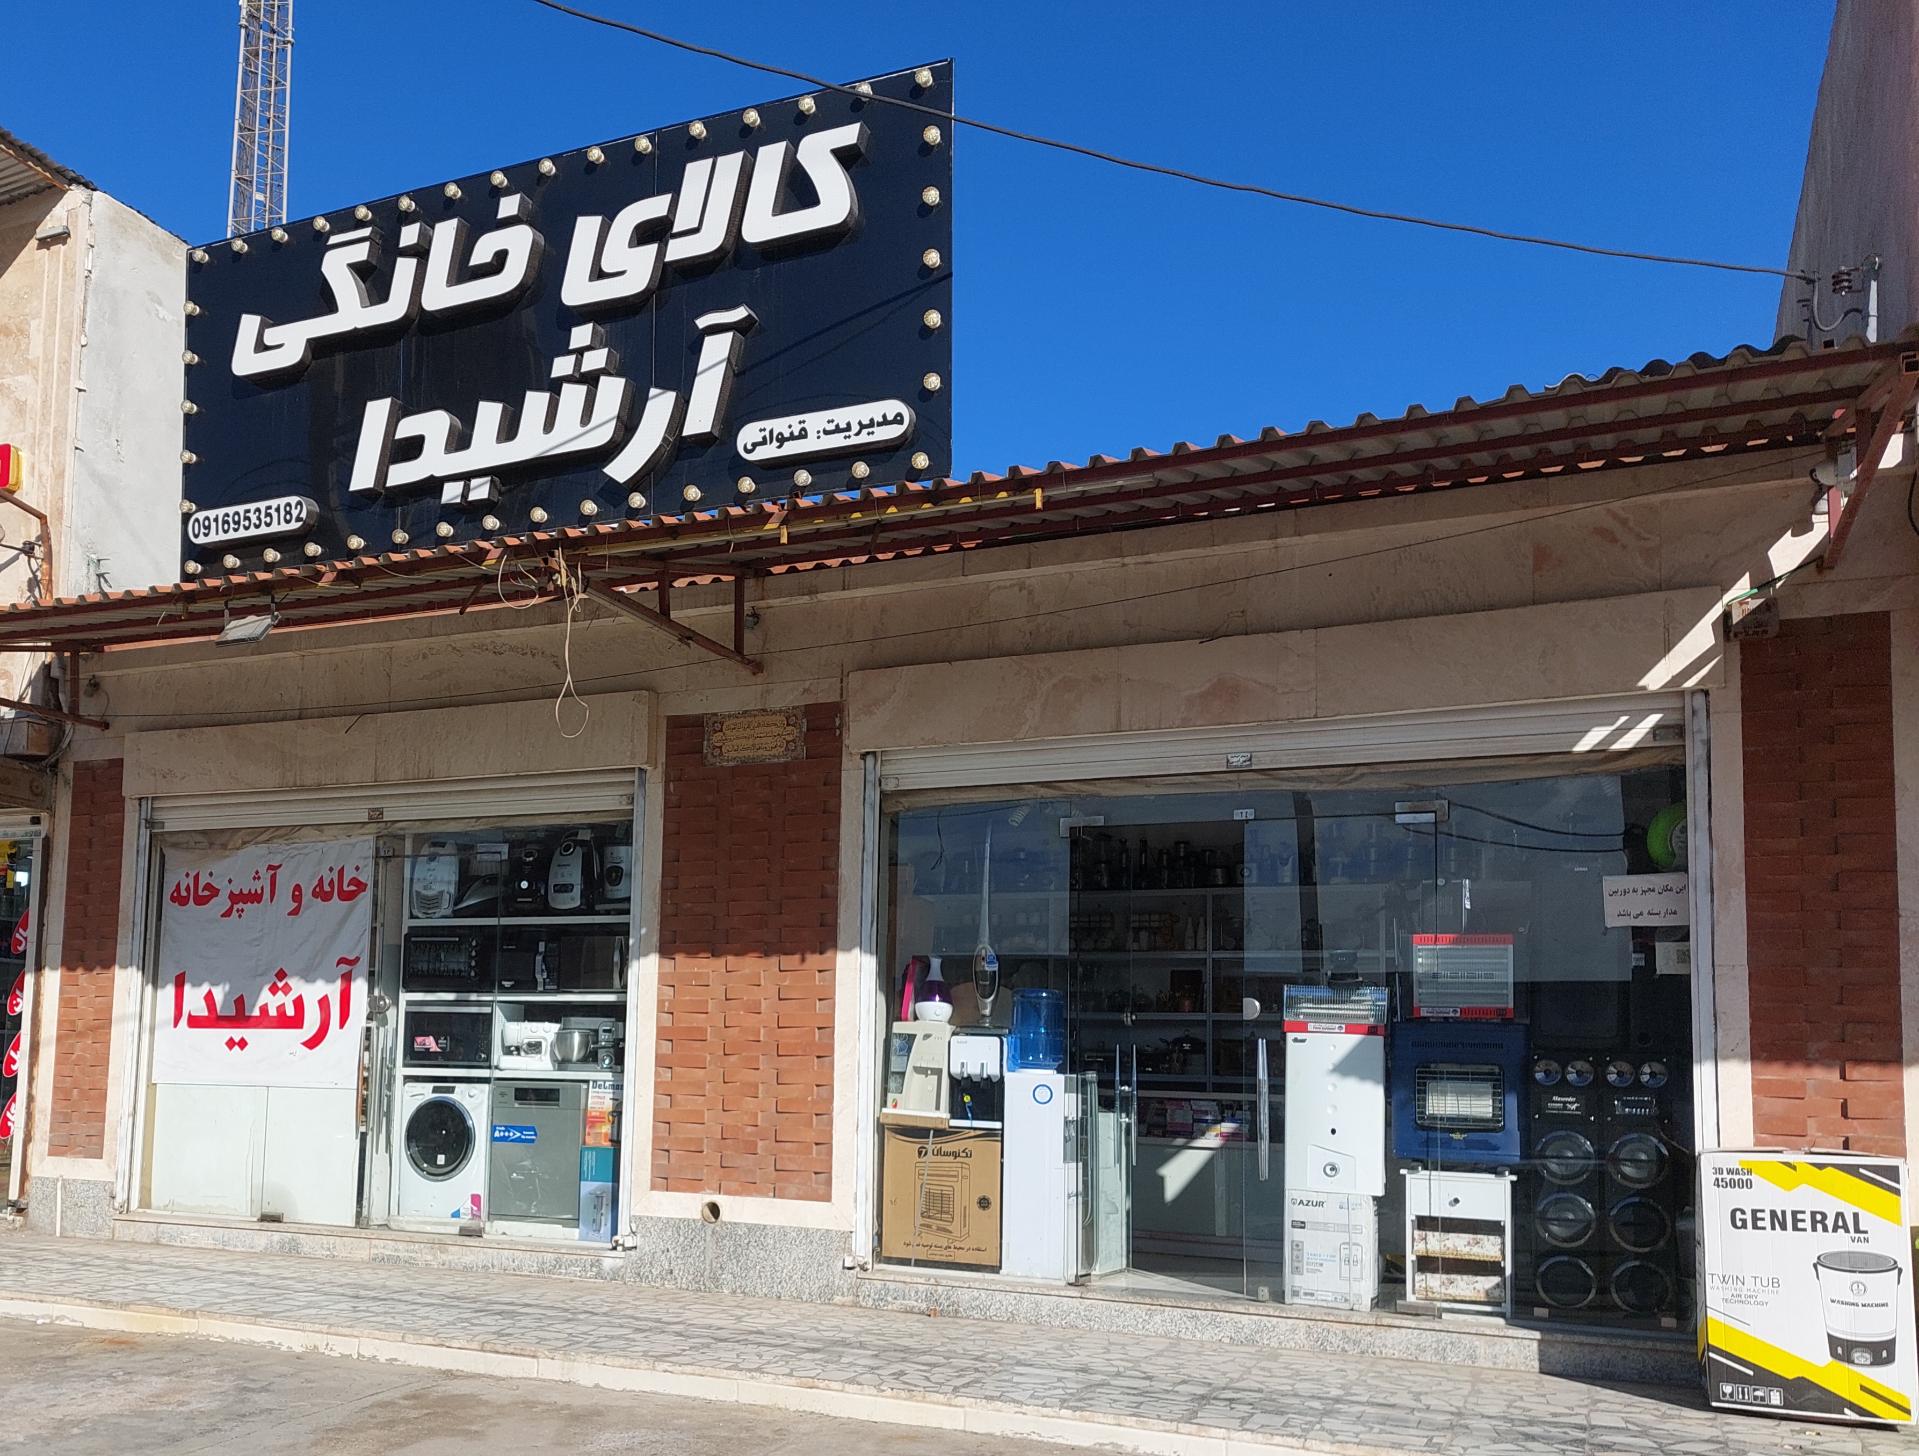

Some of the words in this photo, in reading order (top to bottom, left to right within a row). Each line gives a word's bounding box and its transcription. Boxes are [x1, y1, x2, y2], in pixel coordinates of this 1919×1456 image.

[561, 122, 869, 308] کالای
[231, 193, 534, 377] خانگی
[348, 303, 755, 503] آرشیدا
[743, 418, 809, 454] قنواتی
[191, 499, 304, 540] 09169535182
[311, 864, 369, 903] خانه
[1657, 884, 1674, 894] مکان
[1675, 884, 1687, 894] این
[169, 863, 284, 919] آشپزخانه
[1608, 887, 1630, 897] دوربین
[1640, 886, 1656, 896] مجهز
[287, 882, 304, 918] و
[1616, 909, 1632, 918] باشد
[1632, 910, 1644, 919] می
[1646, 909, 1661, 917] بسته
[1662, 908, 1678, 918] مدار
[172, 955, 362, 1052] آرشیدا
[1712, 1167, 1724, 1176] 3D
[1725, 1167, 1753, 1177] WASH
[1713, 1177, 1753, 1190] 45000
[1297, 1199, 1325, 1208] AZUR
[1730, 1207, 1869, 1235] GENERAL
[1850, 1236, 1870, 1245] VAN
[1708, 1273, 1745, 1287] TWIN
[1751, 1275, 1781, 1289] TUB
[1710, 1285, 1743, 1293] WASHING
[1746, 1288, 1779, 1296] MACHINE
[1721, 1298, 1769, 1307] TECHNOLOGY
[1829, 1297, 1860, 1308] WASHING
[1861, 1301, 1889, 1309] MACHINE
